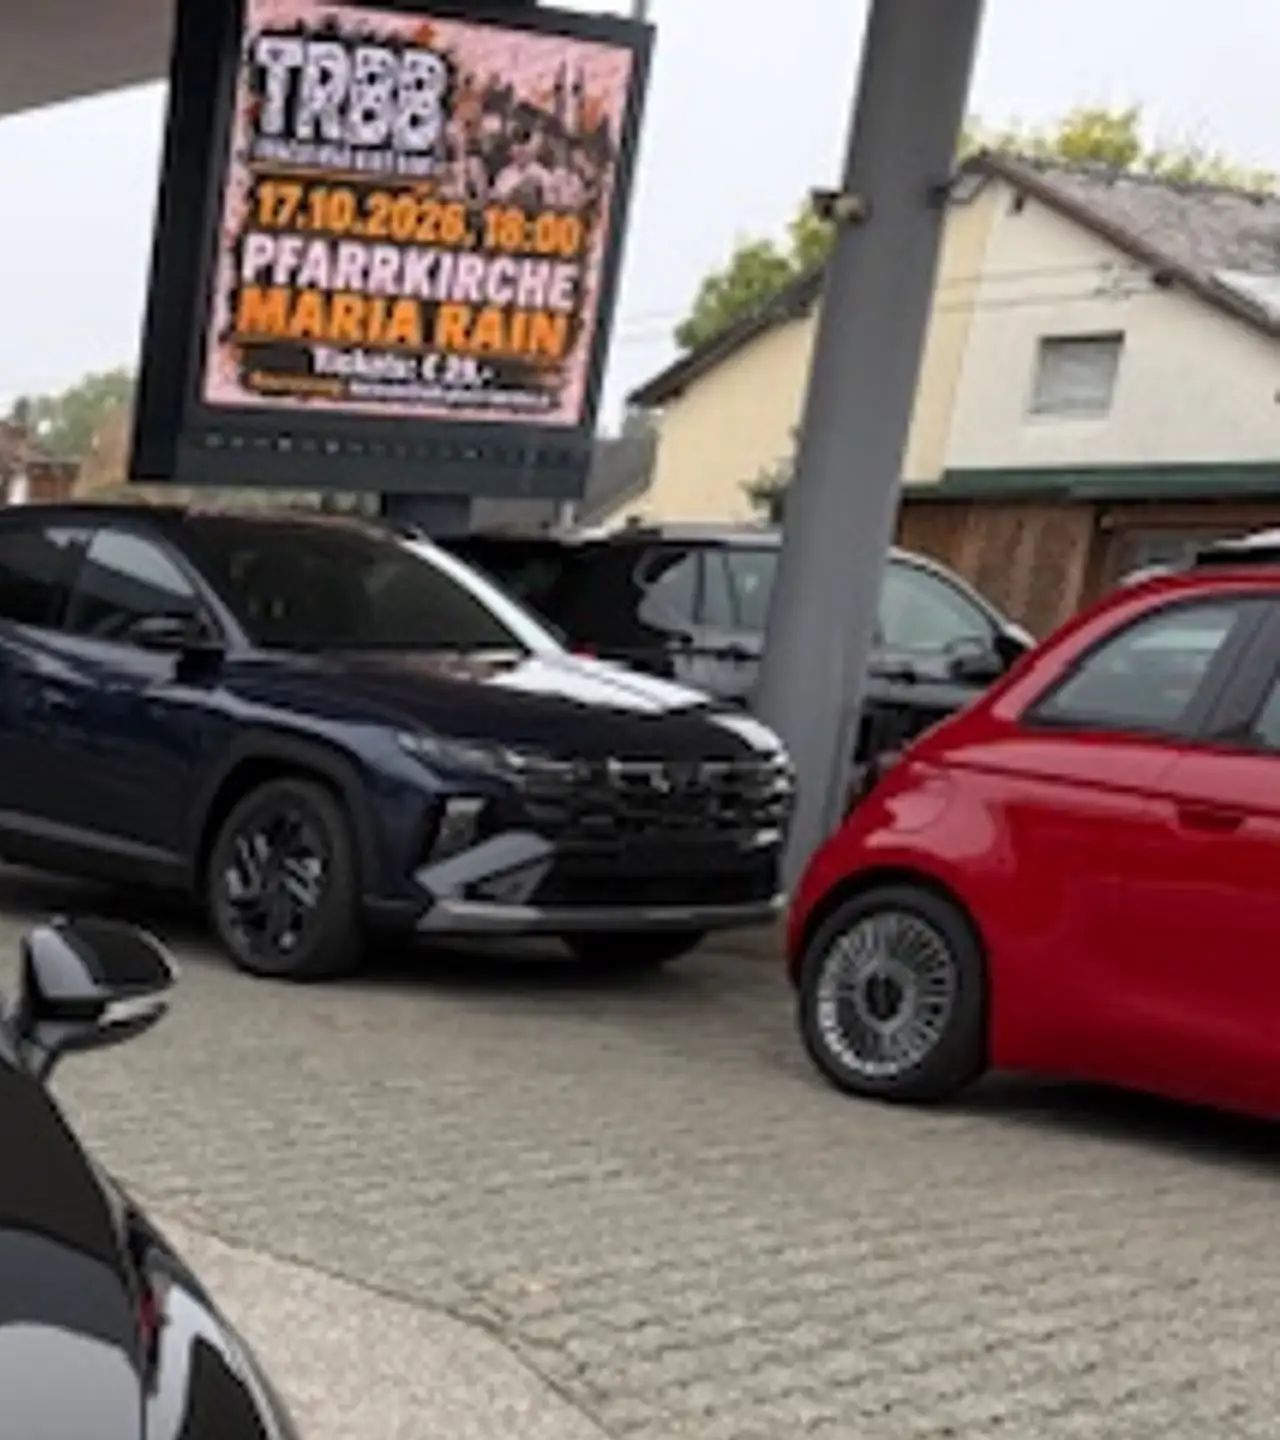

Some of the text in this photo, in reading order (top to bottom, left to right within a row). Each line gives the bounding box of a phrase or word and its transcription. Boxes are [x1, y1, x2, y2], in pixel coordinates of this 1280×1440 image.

[241, 233, 578, 309] PFARRKIRCHE
[239, 286, 568, 357] MARIA RAIN
